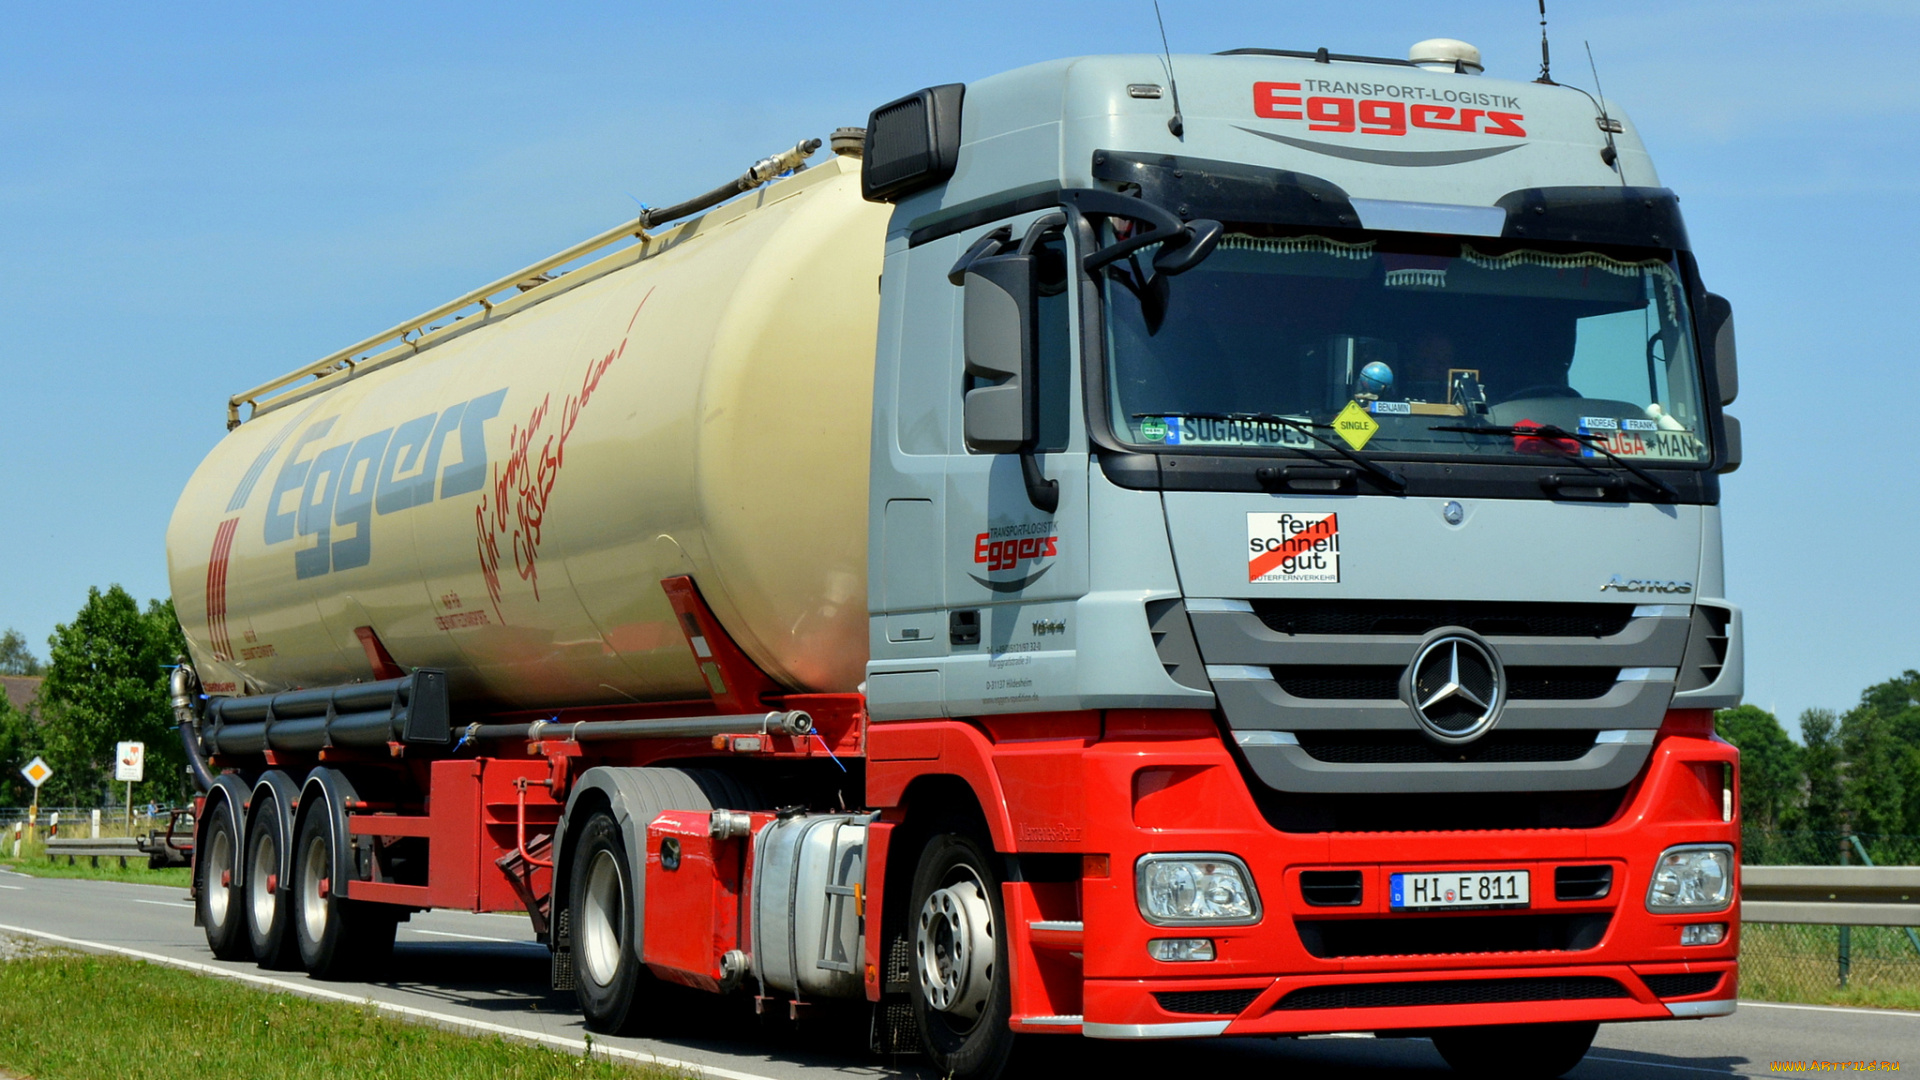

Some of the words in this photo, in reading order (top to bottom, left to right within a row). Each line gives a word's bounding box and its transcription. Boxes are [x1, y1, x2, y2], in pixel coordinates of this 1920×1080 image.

[1304, 78, 1521, 110] TRANSPORT-LOGISTIK
[1253, 81, 1527, 137] Eggers
[1377, 401, 1409, 413] BENJAMIN
[1340, 420, 1370, 431] SINGLE
[1587, 419, 1616, 428] ANDREAS
[1629, 421, 1655, 429] FRANK
[263, 386, 509, 580] Eggers
[990, 520, 1060, 539] TRANSPORT-LOGISTIK
[1277, 513, 1329, 534] fern
[974, 531, 1059, 571] Eggers
[1250, 534, 1339, 552] schnell
[1281, 552, 1327, 574] gut
[1600, 577, 1693, 594] Actros
[1414, 877, 1442, 903] HI
[1459, 877, 1473, 901] E
[1478, 875, 1519, 901] 811
